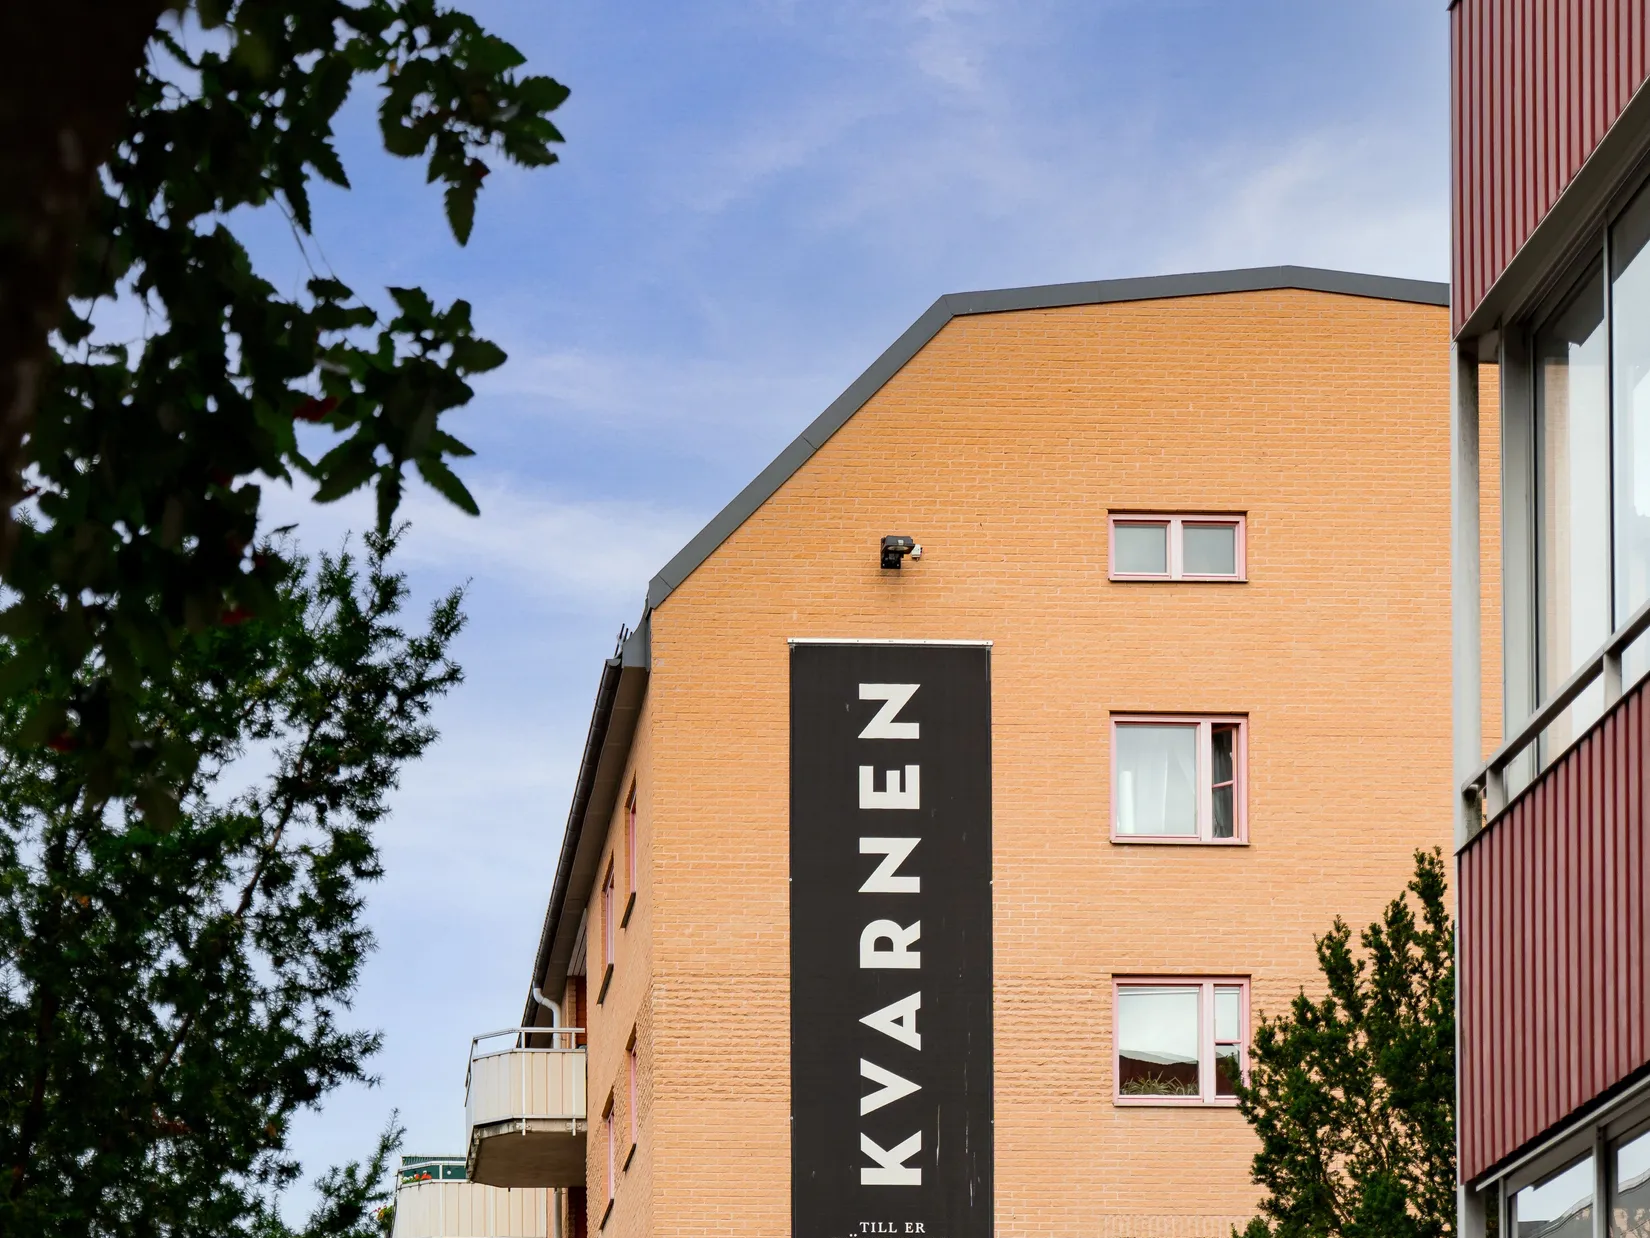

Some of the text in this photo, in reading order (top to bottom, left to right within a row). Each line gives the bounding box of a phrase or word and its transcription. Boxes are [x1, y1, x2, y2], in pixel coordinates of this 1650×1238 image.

[858, 683, 922, 1185] KVARNEN
[859, 1221, 926, 1234] TILL ER
